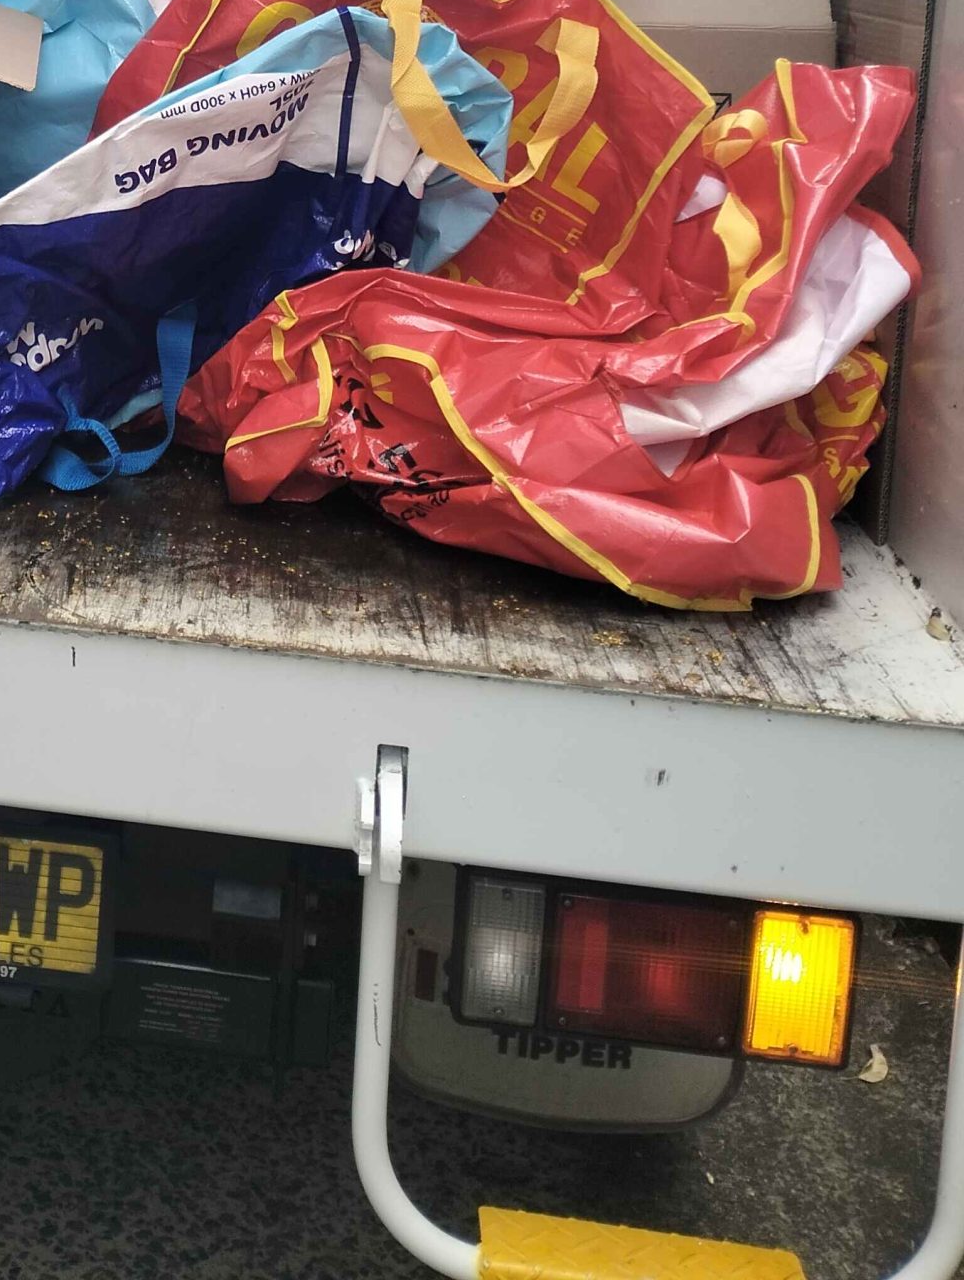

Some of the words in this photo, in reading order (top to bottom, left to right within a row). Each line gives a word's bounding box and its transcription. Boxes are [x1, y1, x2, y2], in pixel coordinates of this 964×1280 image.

[190, 94, 226, 113] 300D
[240, 80, 277, 97] 640H
[160, 106, 187, 120] mm
[186, 92, 310, 157] MOVING
[114, 147, 178, 194] BAG
[491, 1026, 633, 1070] TIPPER
